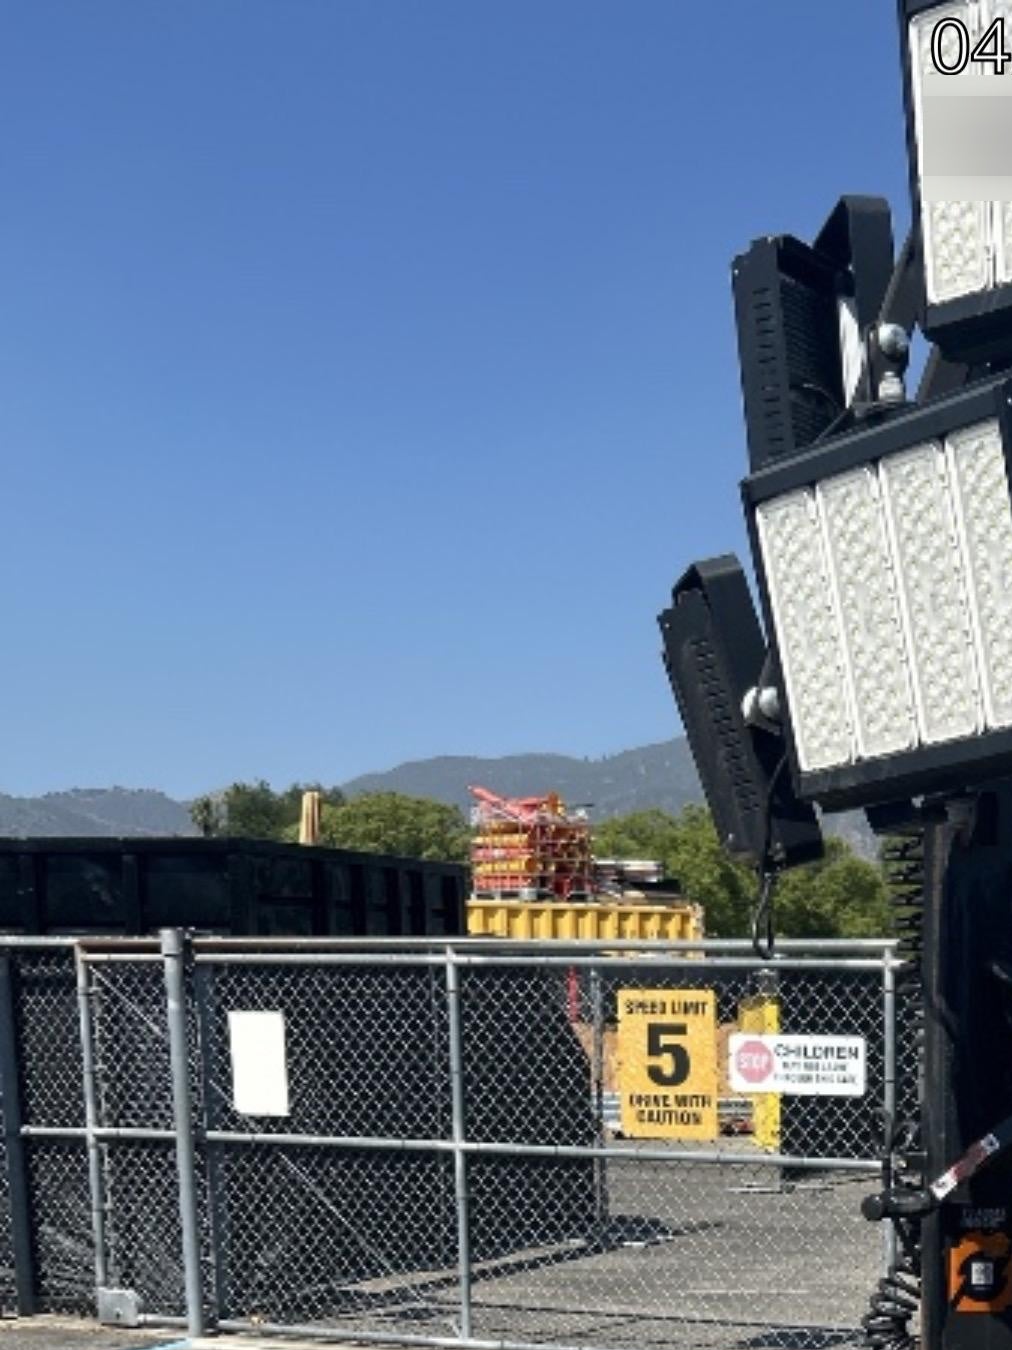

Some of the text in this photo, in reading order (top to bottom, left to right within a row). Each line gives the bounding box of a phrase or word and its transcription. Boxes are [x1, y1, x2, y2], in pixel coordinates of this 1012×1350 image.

[625, 1000, 708, 1016] SPEED LIMIT
[646, 1022, 691, 1087] 5
[774, 1043, 859, 1060] CHILDREN
[674, 1094, 712, 1108] WITH
[636, 1109, 703, 1126] CAUTION
